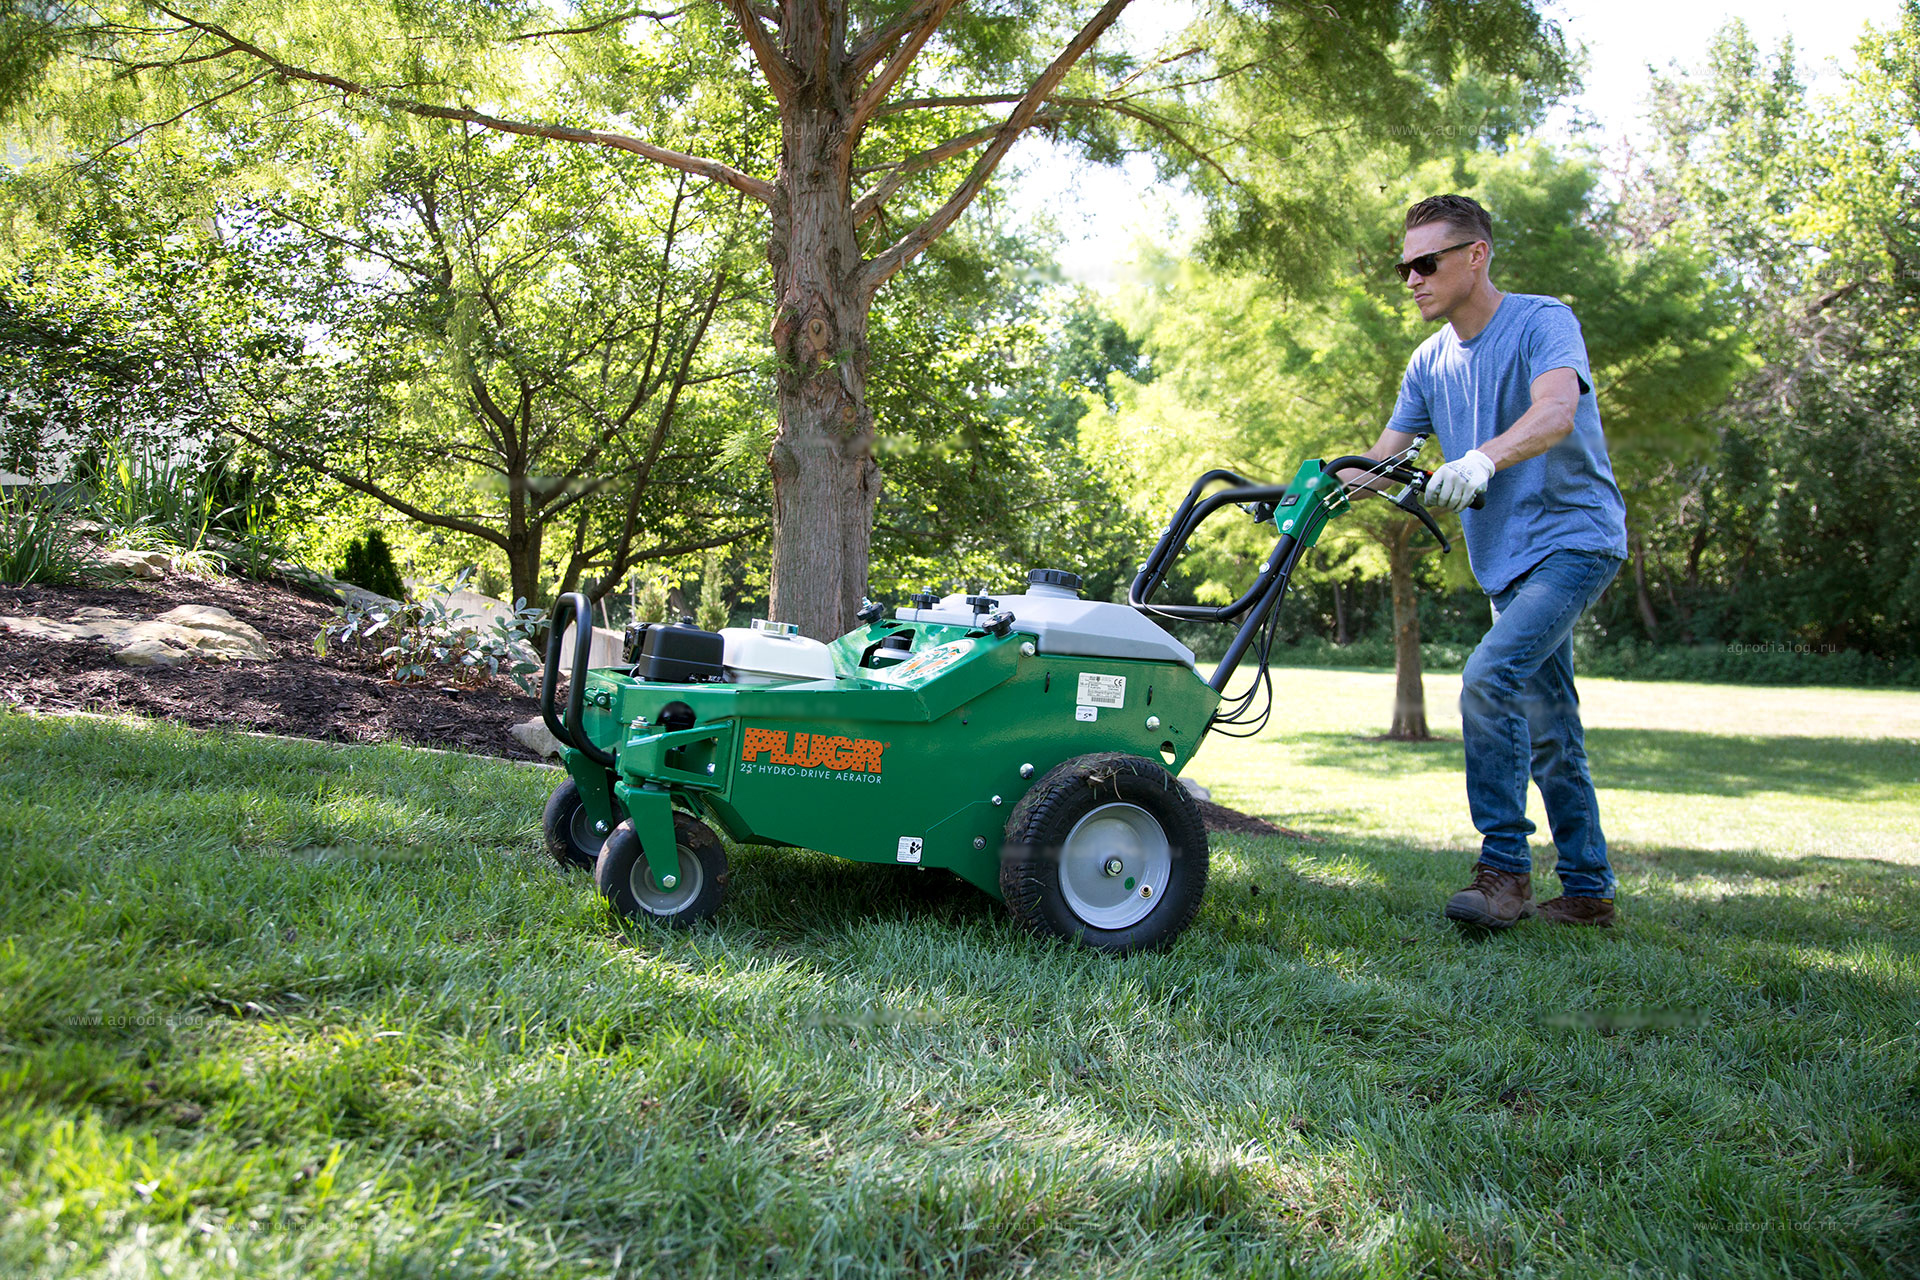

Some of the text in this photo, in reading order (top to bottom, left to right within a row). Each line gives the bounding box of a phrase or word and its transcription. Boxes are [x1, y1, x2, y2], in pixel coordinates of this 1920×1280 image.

[742, 727, 884, 773] PLUGR
[758, 765, 831, 780] HYDRO-DRIVE
[835, 772, 882, 784] AERATOR
